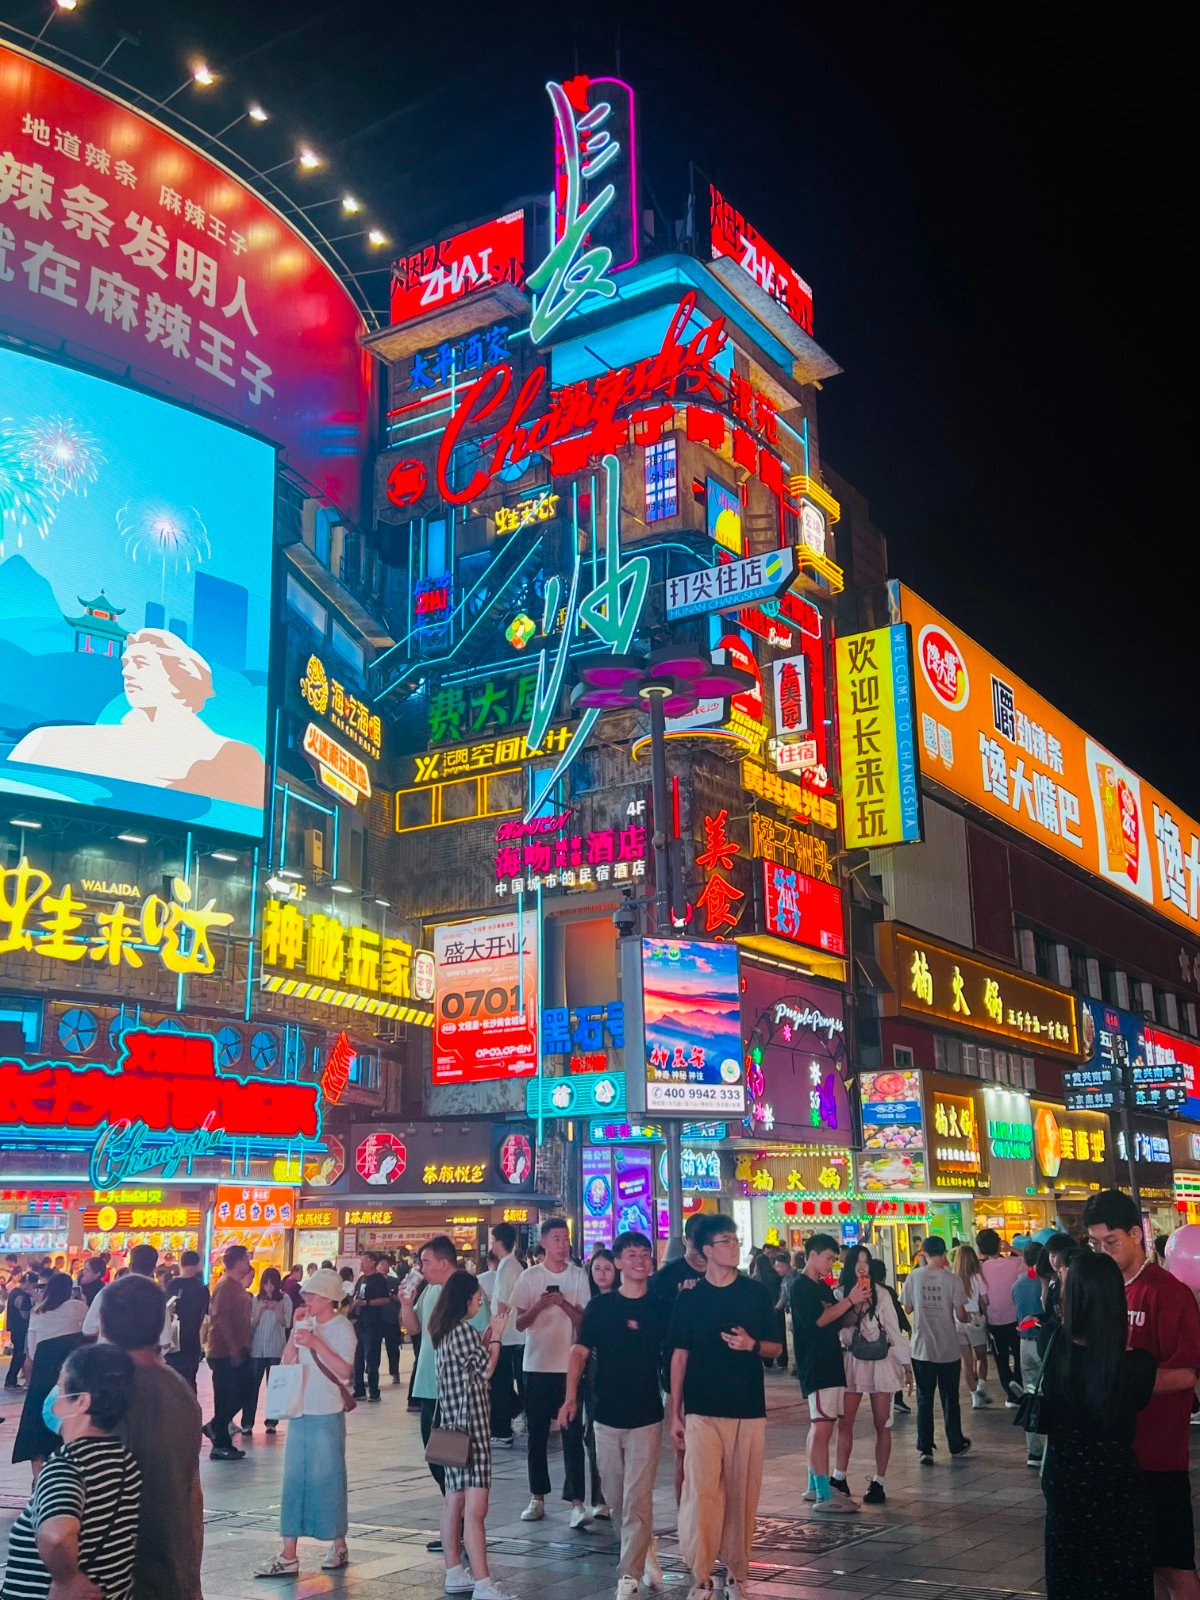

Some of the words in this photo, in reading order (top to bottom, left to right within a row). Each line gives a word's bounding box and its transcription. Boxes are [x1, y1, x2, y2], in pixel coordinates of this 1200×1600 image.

[21, 112, 139, 190] 地道辣条
[158, 184, 249, 256] 麻辣王子
[0, 151, 259, 337] 辣条发明人
[670, 558, 762, 607] 打尖住店
[670, 603, 706, 619] HUNAN
[709, 587, 765, 609] CHANGSHA
[893, 632, 909, 705] WELCOME
[848, 636, 887, 839] 欢迎长来玩
[897, 713, 910, 733] TO
[778, 742, 816, 765] 住宿
[899, 739, 916, 828] CHANGSHA
[978, 730, 1083, 848] 馋大嘴巴
[626, 800, 646, 816] 4F
[587, 824, 646, 864] 酒店
[495, 860, 646, 897] 中国城市的民宿酒店
[695, 809, 745, 931] 美食
[81, 878, 141, 898] WALAIDA
[0, 856, 235, 974] 蛙来哒
[262, 900, 413, 999] 神秘玩家
[444, 933, 528, 965] 盛大开业
[441, 984, 526, 1019] 0701
[911, 950, 1003, 1025] 楠火锅
[1072, 1069, 1112, 1083] 黄兴南路
[1132, 1067, 1174, 1080] 黄兴南路
[664, 1088, 685, 1099] 400
[689, 1088, 716, 1099] 9942
[720, 1090, 740, 1100] 333
[89, 1110, 226, 1190] Changsha
[422, 1164, 484, 1185] 茶颜悦色
[753, 1166, 841, 1192] 楠火锅
[217, 1203, 293, 1221] 芋泥香酥鸭
[295, 1212, 332, 1227] 茶颜悦色
[350, 1211, 393, 1226] 茶颜悦色
